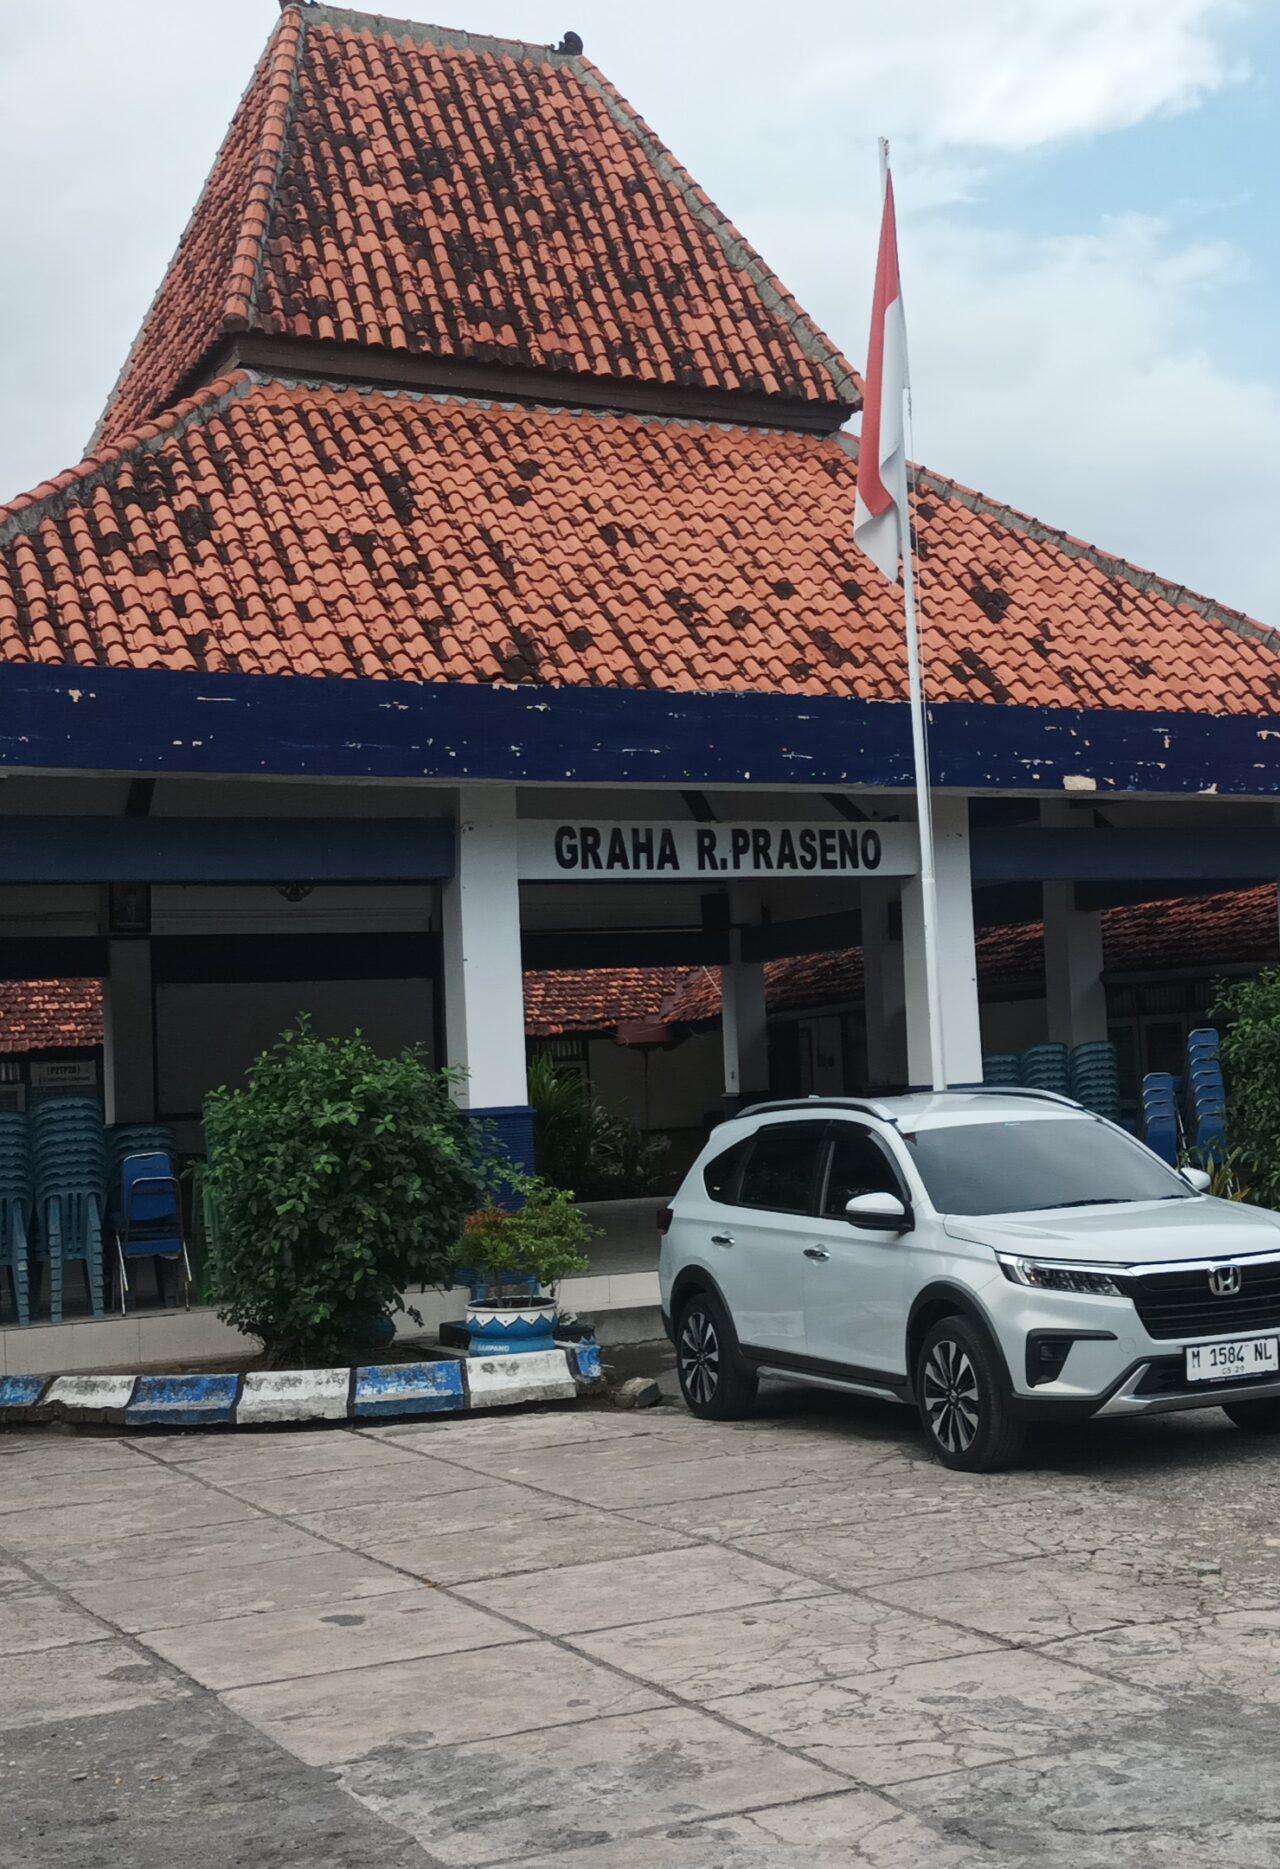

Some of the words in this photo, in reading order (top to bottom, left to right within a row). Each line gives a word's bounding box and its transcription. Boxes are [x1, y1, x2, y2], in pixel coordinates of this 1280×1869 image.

[554, 825, 680, 870] GRAHA
[697, 828, 882, 871] R.PRASENO
[1192, 1351, 1200, 1368] M
[1209, 1345, 1245, 1366] 1584
[1254, 1342, 1272, 1361] NL
